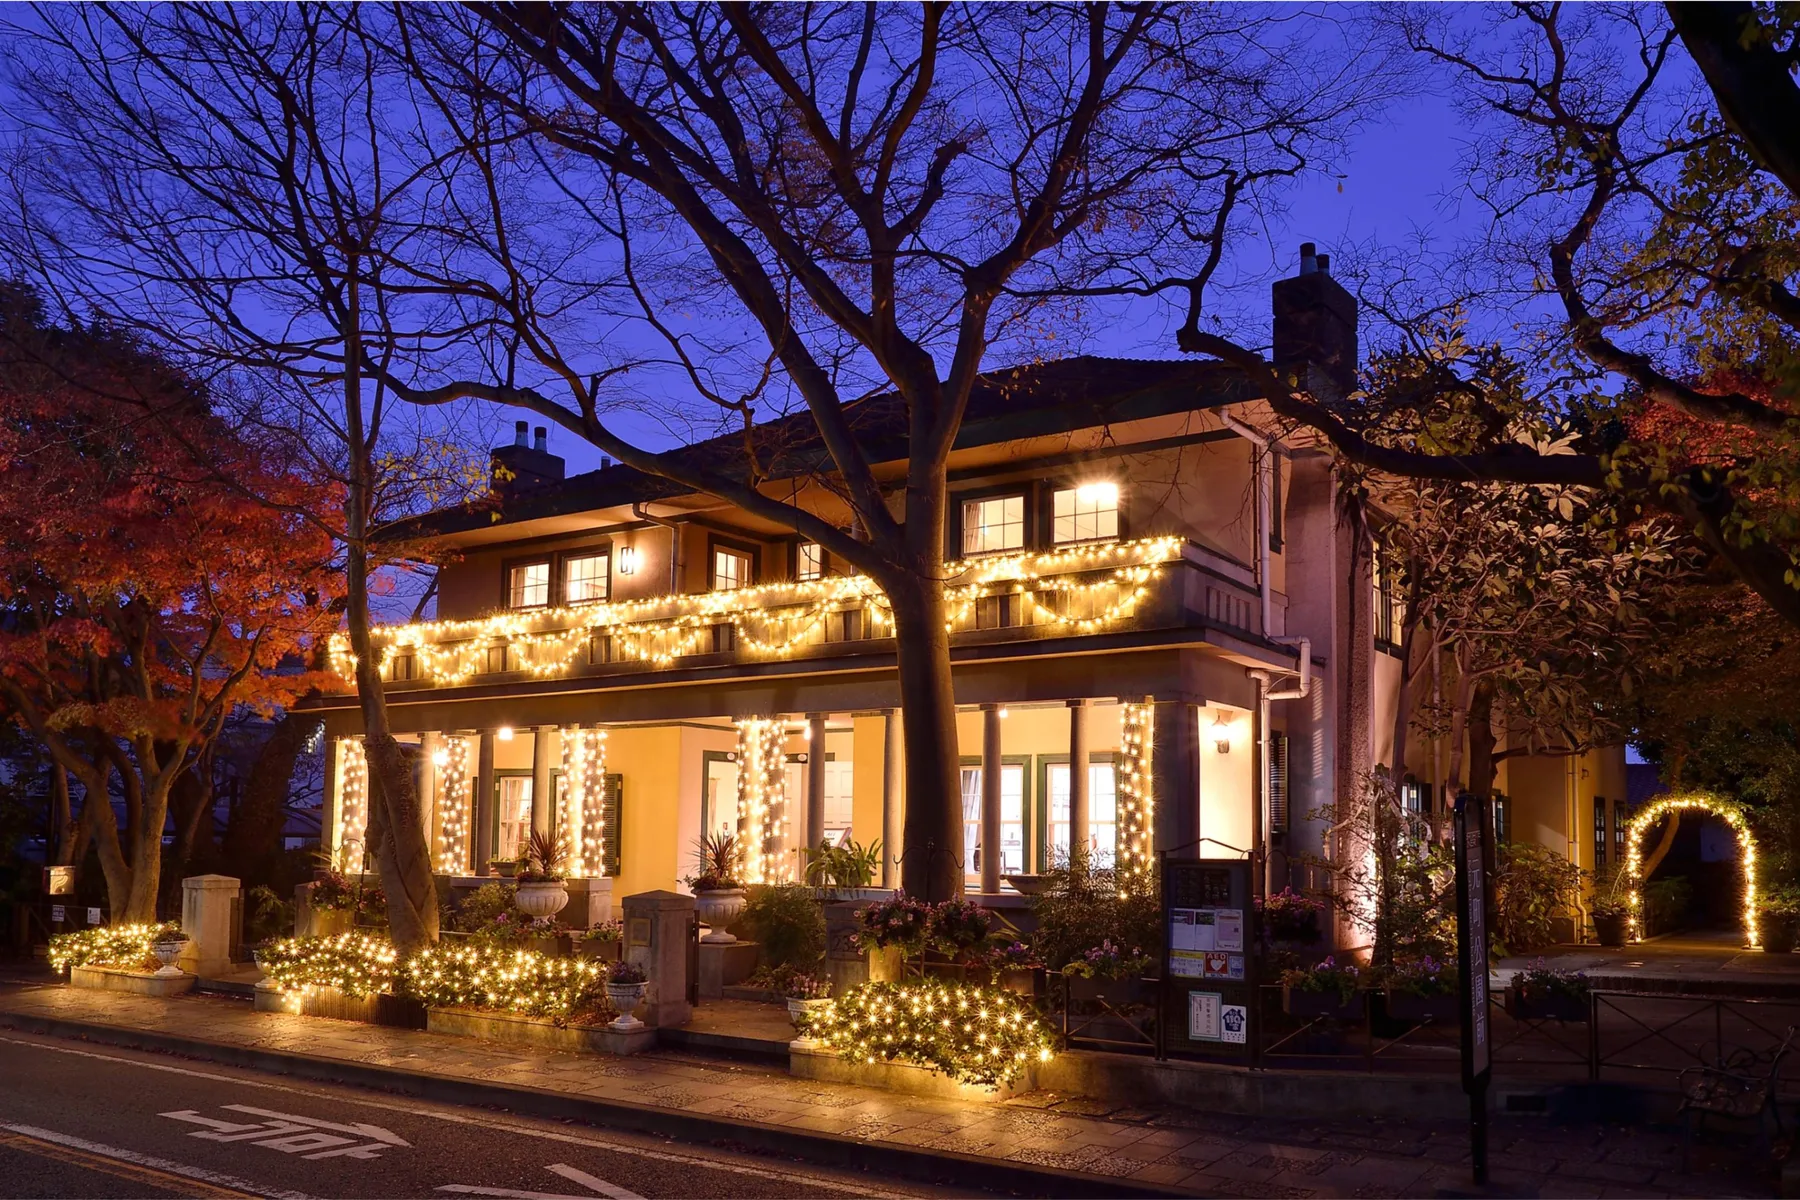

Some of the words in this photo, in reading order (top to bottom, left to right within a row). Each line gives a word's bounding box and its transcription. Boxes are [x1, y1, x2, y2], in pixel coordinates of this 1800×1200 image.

[1471, 858, 1485, 1045] 元町公園前
